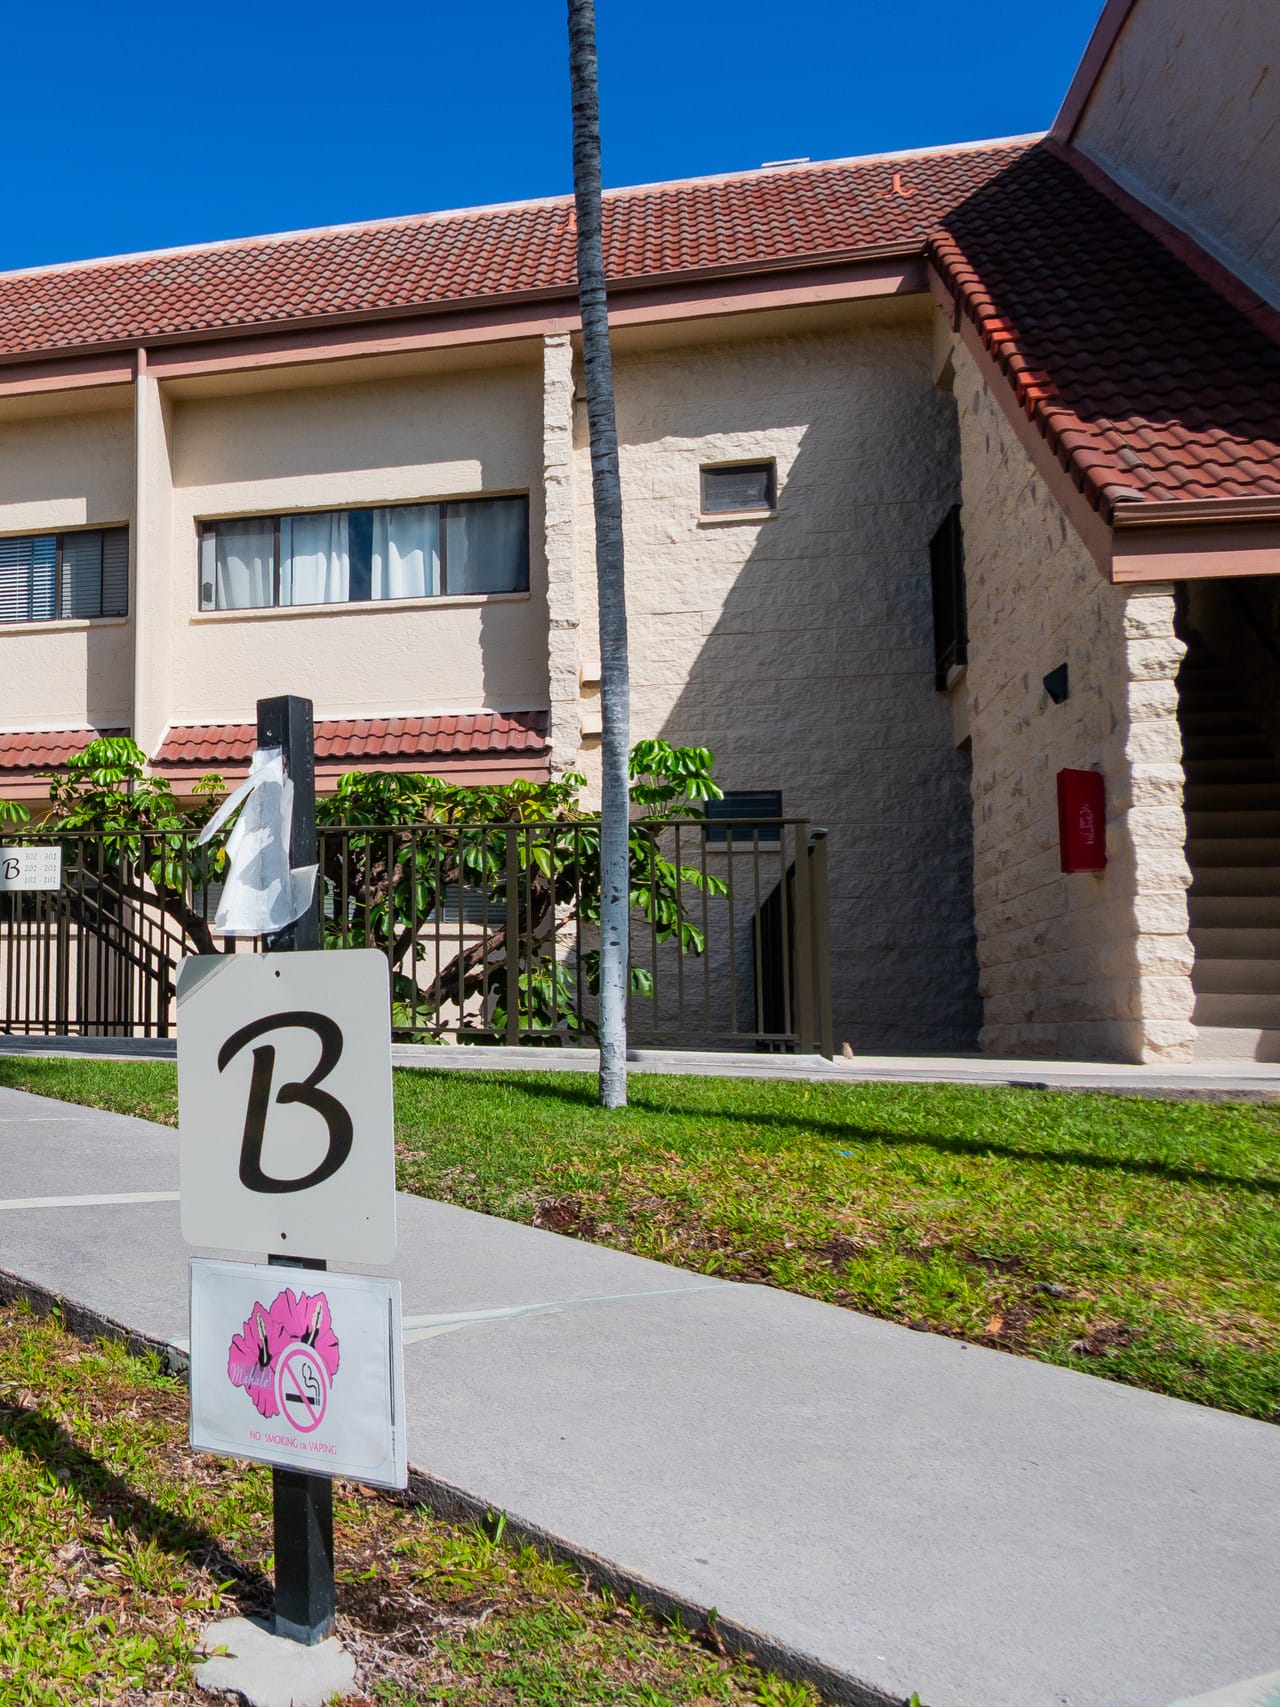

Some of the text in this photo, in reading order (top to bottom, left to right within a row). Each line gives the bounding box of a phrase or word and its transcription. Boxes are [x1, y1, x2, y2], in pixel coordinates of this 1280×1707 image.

[1, 857, 21, 880] B
[217, 1011, 354, 1194] B
[249, 1430, 262, 1441] NO
[264, 1433, 298, 1449] SMOKING
[309, 1441, 337, 1456] VAPING
